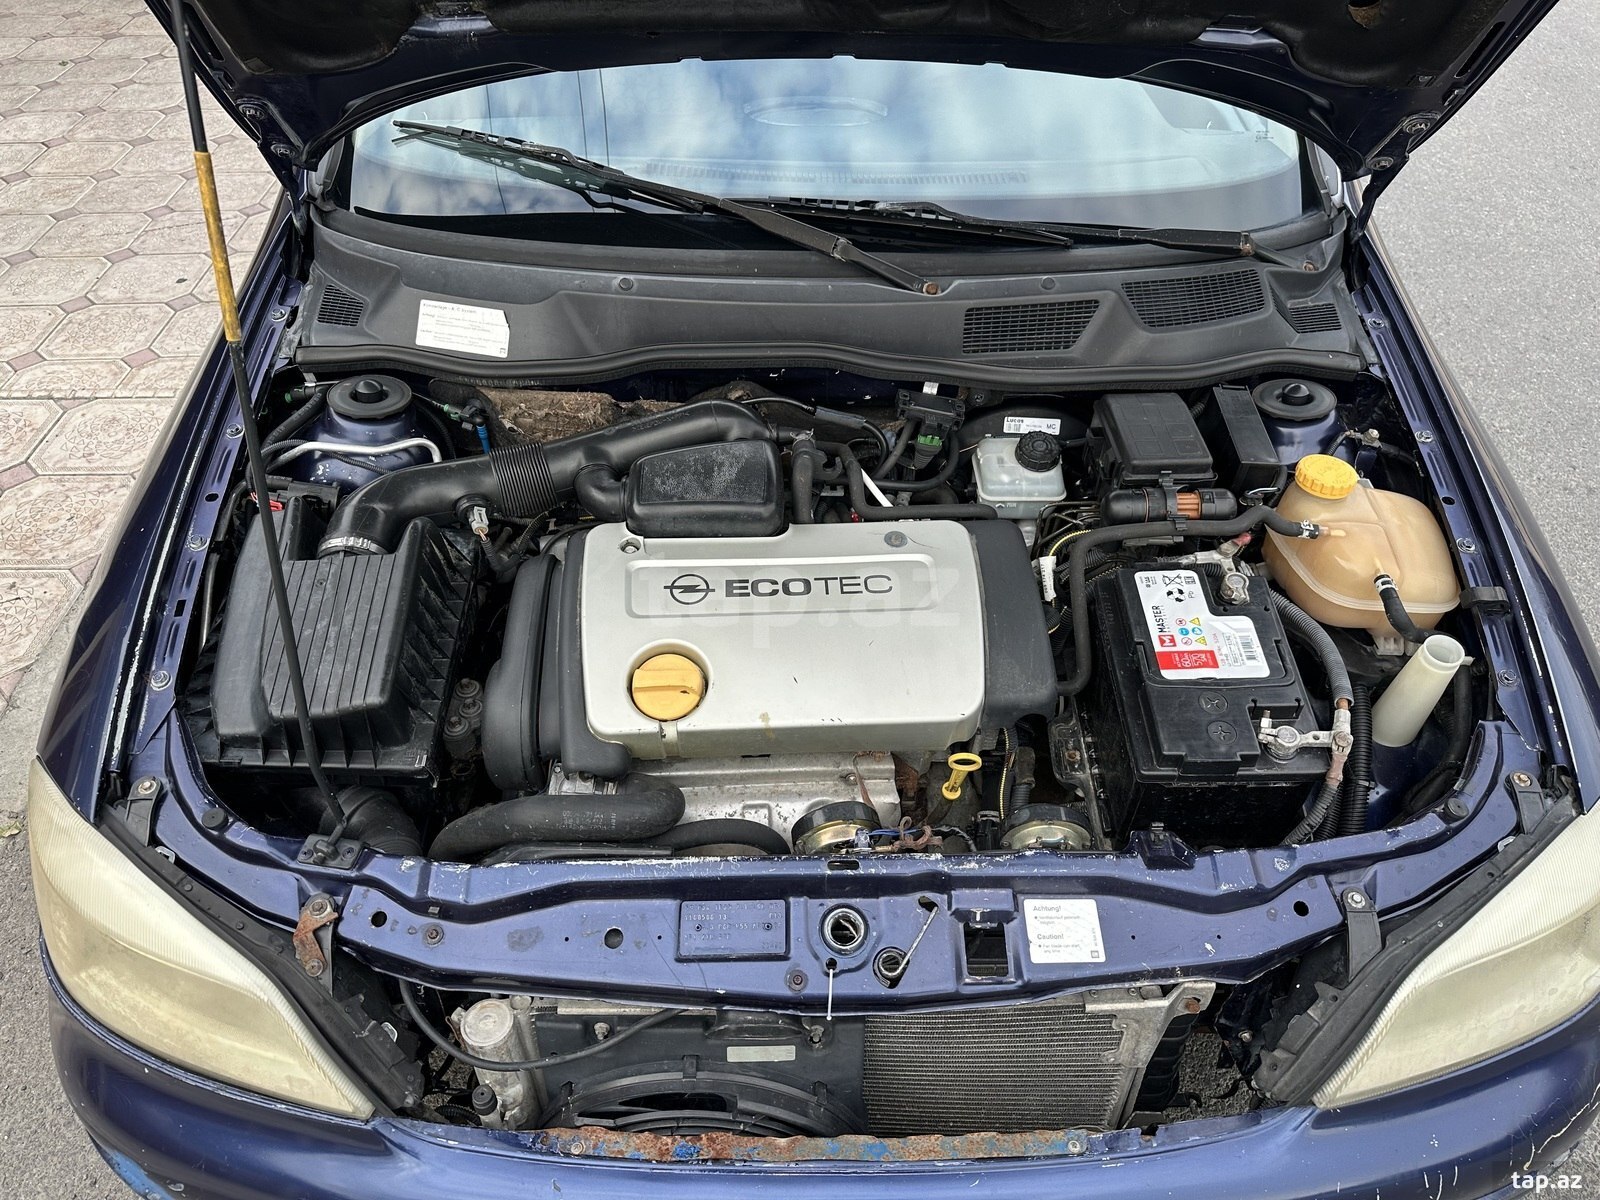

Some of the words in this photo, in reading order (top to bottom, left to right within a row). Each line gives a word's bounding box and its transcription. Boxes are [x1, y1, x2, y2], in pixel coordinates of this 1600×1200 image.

[725, 575, 893, 598] ECOTEC
[1152, 605, 1167, 633] MASTER
[1033, 905, 1062, 913] Achtung!
